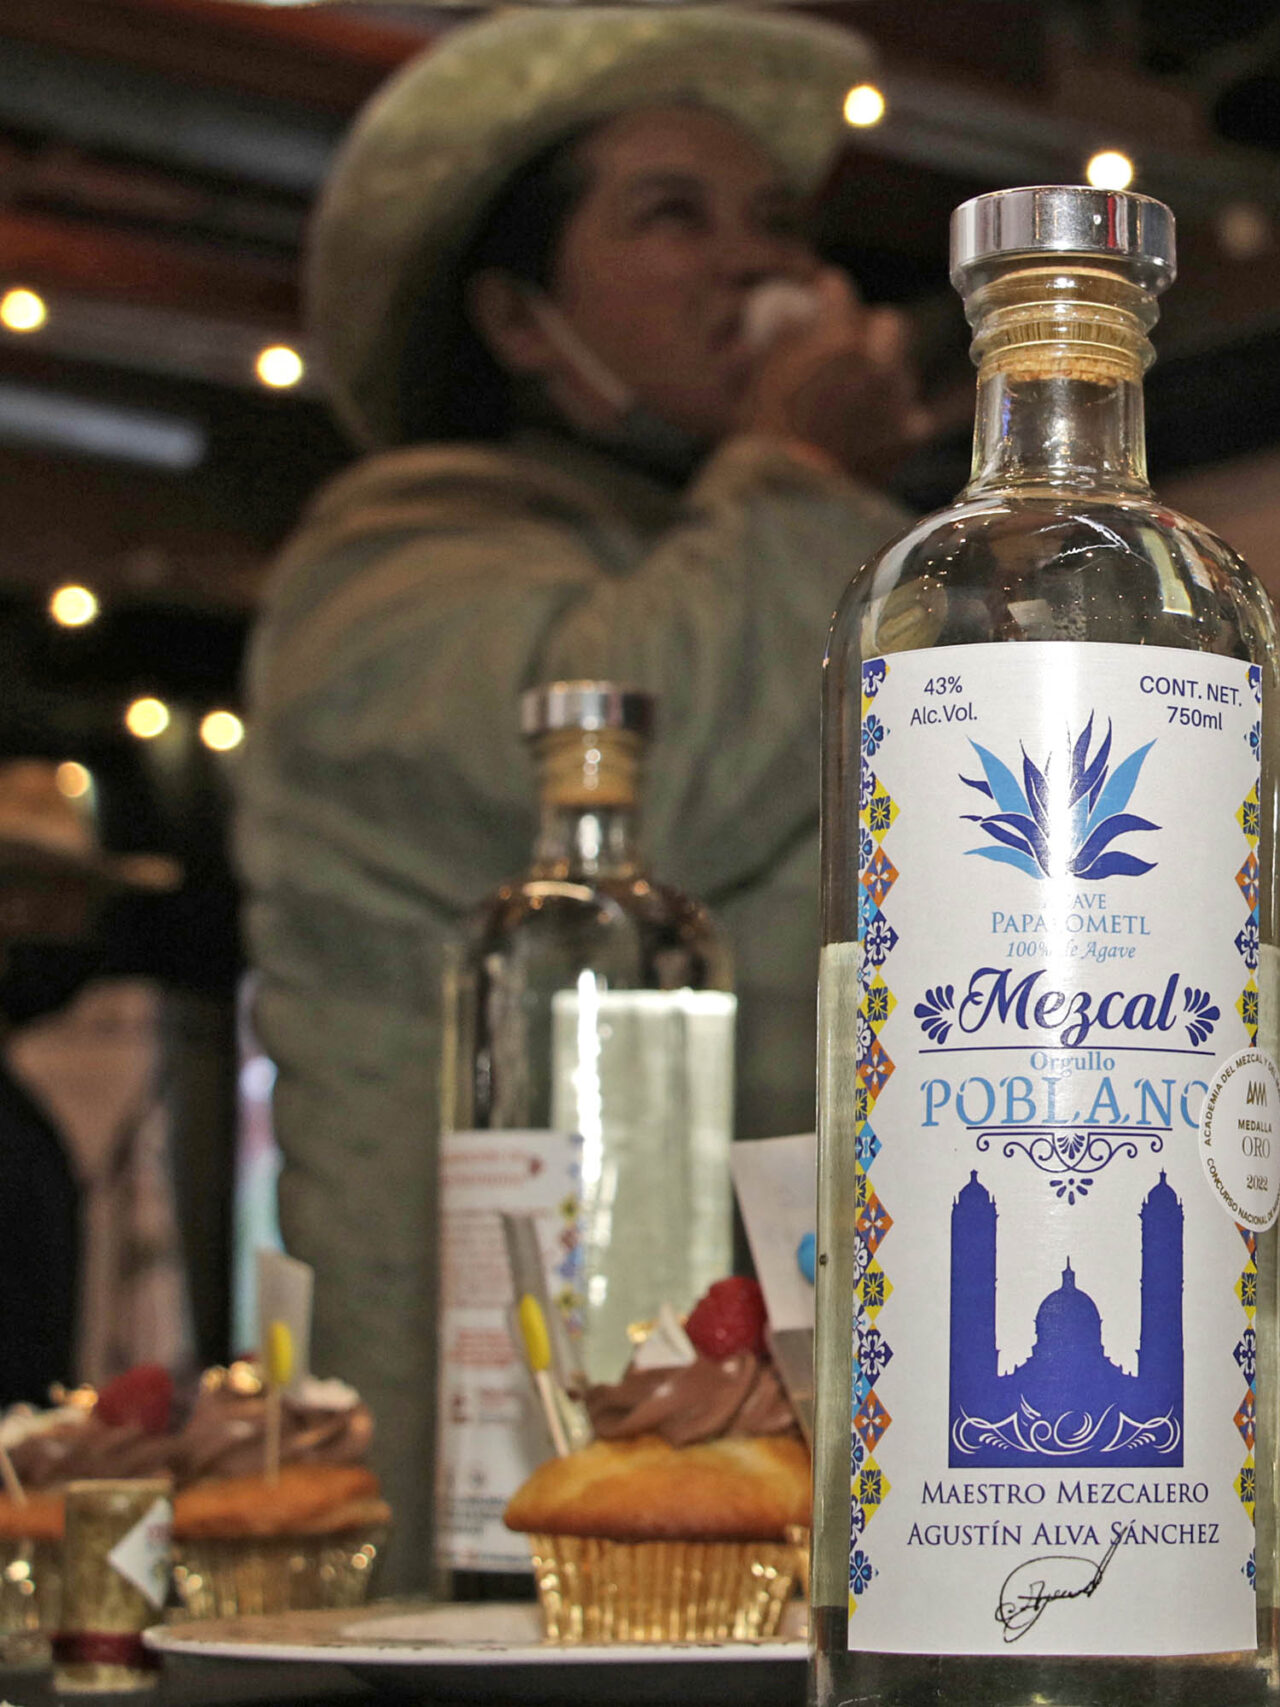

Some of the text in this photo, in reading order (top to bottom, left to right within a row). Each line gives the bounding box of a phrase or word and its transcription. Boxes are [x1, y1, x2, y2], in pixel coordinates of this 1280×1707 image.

[924, 676, 963, 695] 43%
[1140, 675, 1242, 707] CONT. NET.
[1167, 706, 1222, 730] 750ml
[991, 911, 1151, 935] PAPAOMETL
[1081, 941, 1136, 963] Agave
[958, 967, 1181, 1048] Mezcal
[1030, 1050, 1115, 1078] Orgullo
[1204, 1083, 1223, 1147] ACADEMIA
[1220, 1066, 1235, 1083] DEL
[1235, 1053, 1263, 1068] MEZCAL
[1238, 1119, 1272, 1133] MEDALLA
[1242, 1135, 1270, 1158] ORO
[1206, 1158, 1238, 1212] CONCURSO
[1247, 1174, 1268, 1191] 2022
[921, 1480, 1209, 1506] MAESTRO MEZCALERO
[907, 1519, 1220, 1546] AGUSTÍN ALVA SÁNCHEZ
